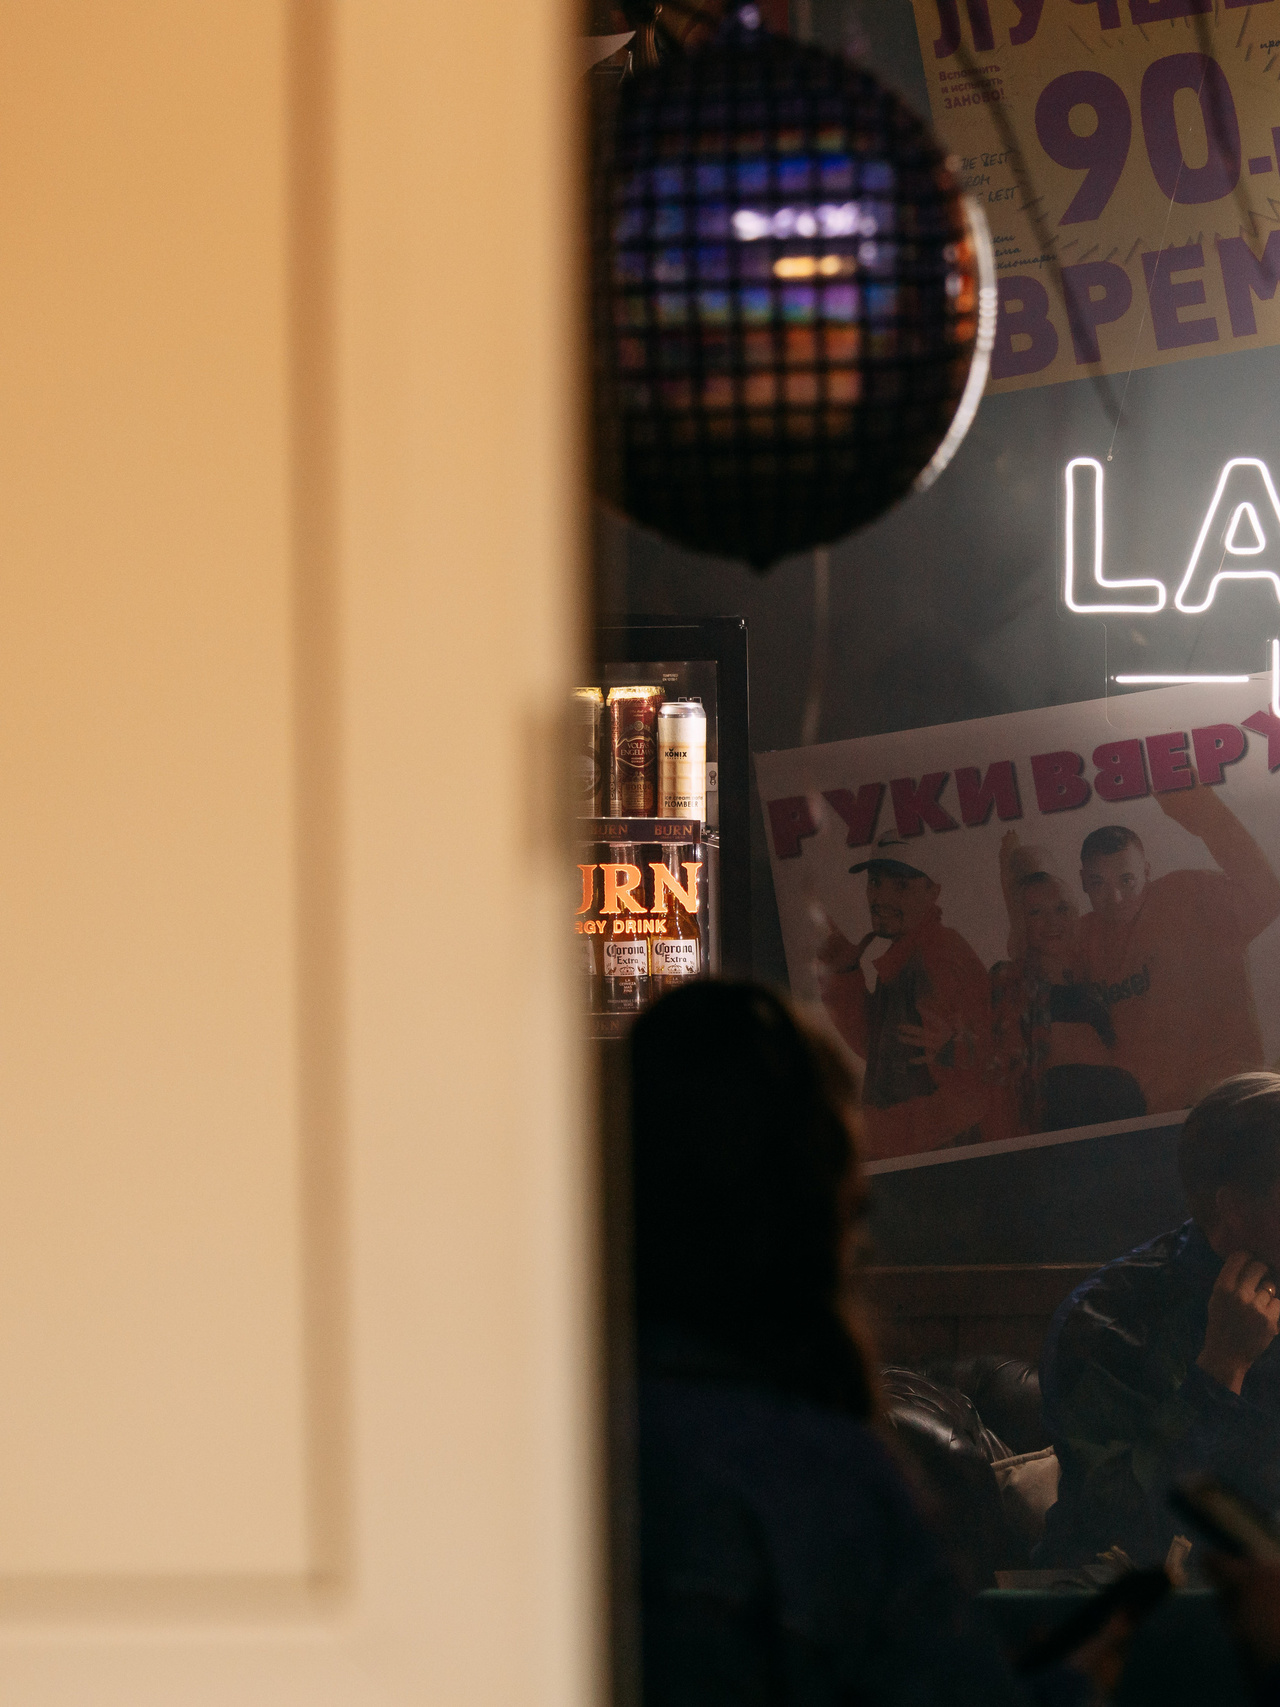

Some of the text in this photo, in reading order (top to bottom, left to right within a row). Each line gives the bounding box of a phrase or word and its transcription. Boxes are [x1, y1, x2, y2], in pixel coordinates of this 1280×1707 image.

[938, 64, 1001, 82] Вспомнить
[941, 86, 949, 95] и
[943, 87, 1006, 110] ЗАНОВО!
[766, 759, 1025, 860] РУКИ
[655, 824, 693, 836] BURN
[575, 918, 668, 935] RGY DRINK
[606, 944, 645, 959] Corona
[654, 942, 694, 958] Corona
[616, 955, 639, 965] Extra
[664, 954, 687, 964] Extra
